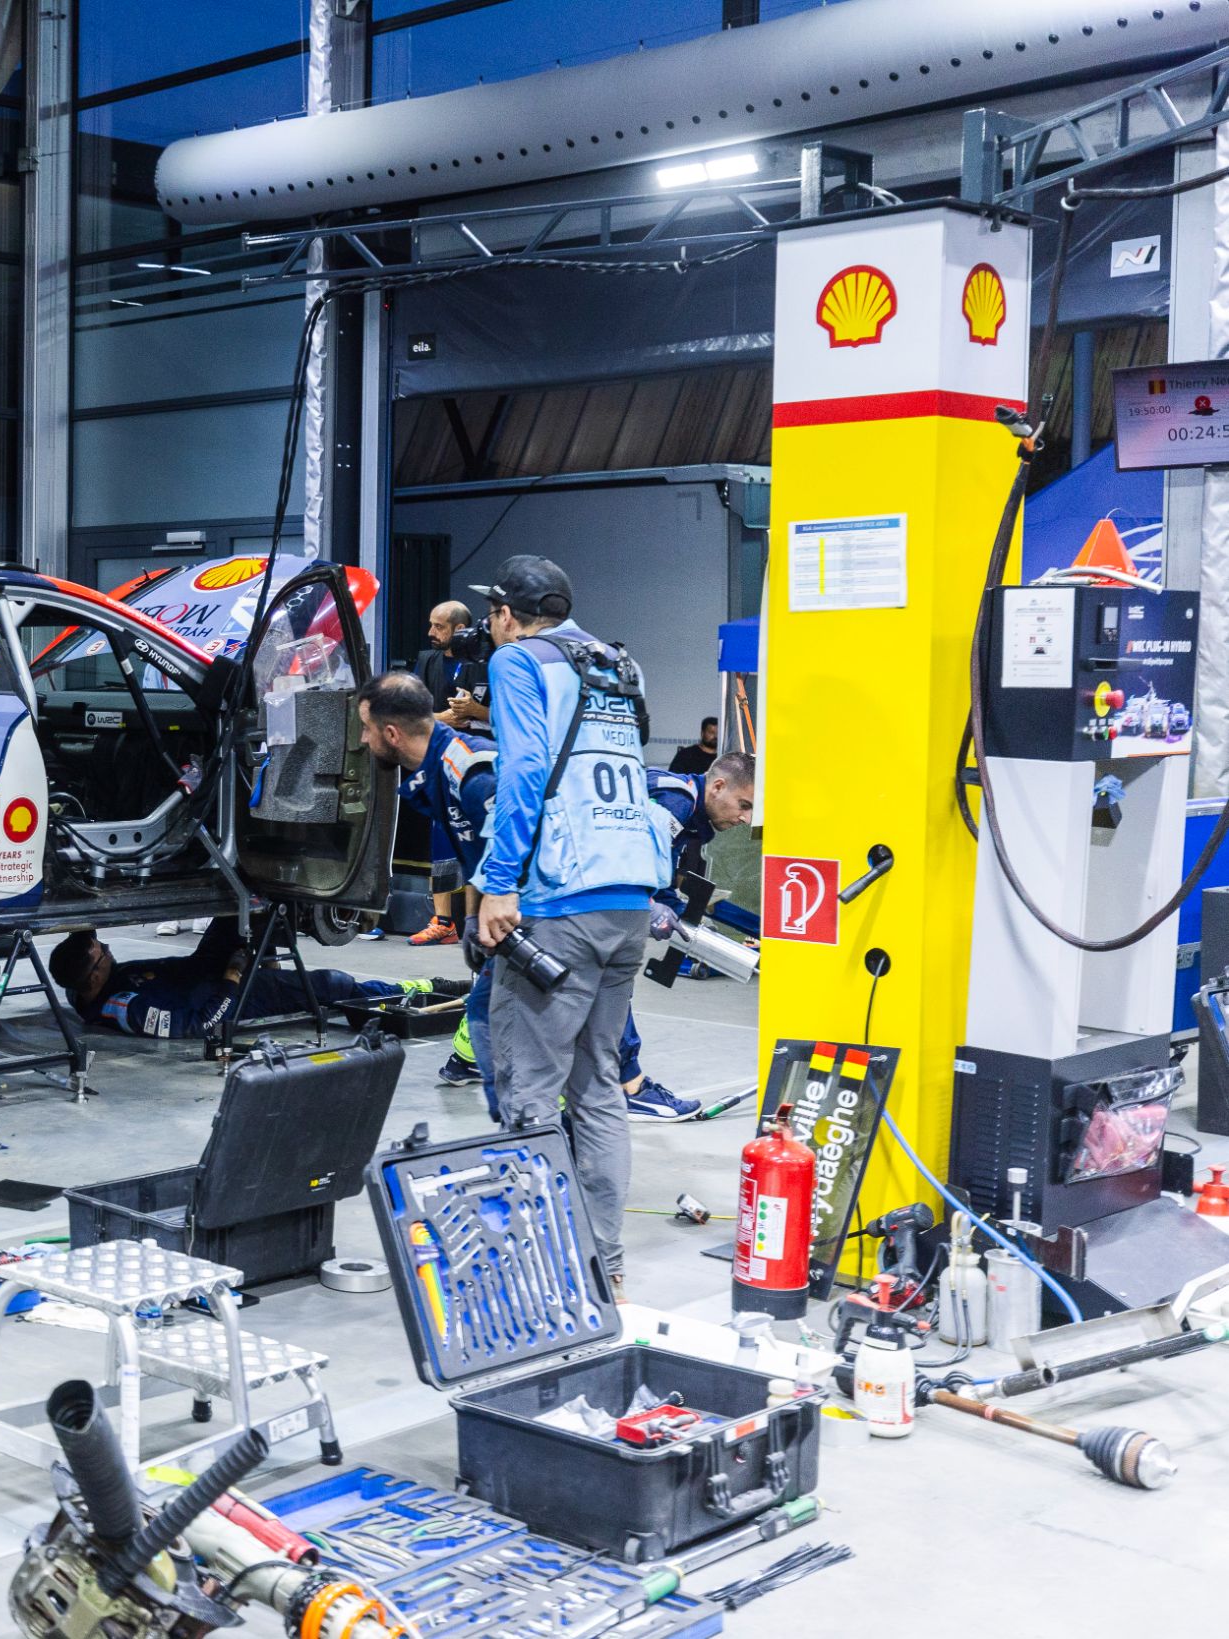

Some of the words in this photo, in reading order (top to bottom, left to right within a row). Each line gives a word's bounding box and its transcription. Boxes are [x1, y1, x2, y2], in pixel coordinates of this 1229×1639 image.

[1170, 380, 1207, 390] Thierry
[1129, 405, 1171, 416] 19:50:00
[792, 1081, 826, 1144] ville
